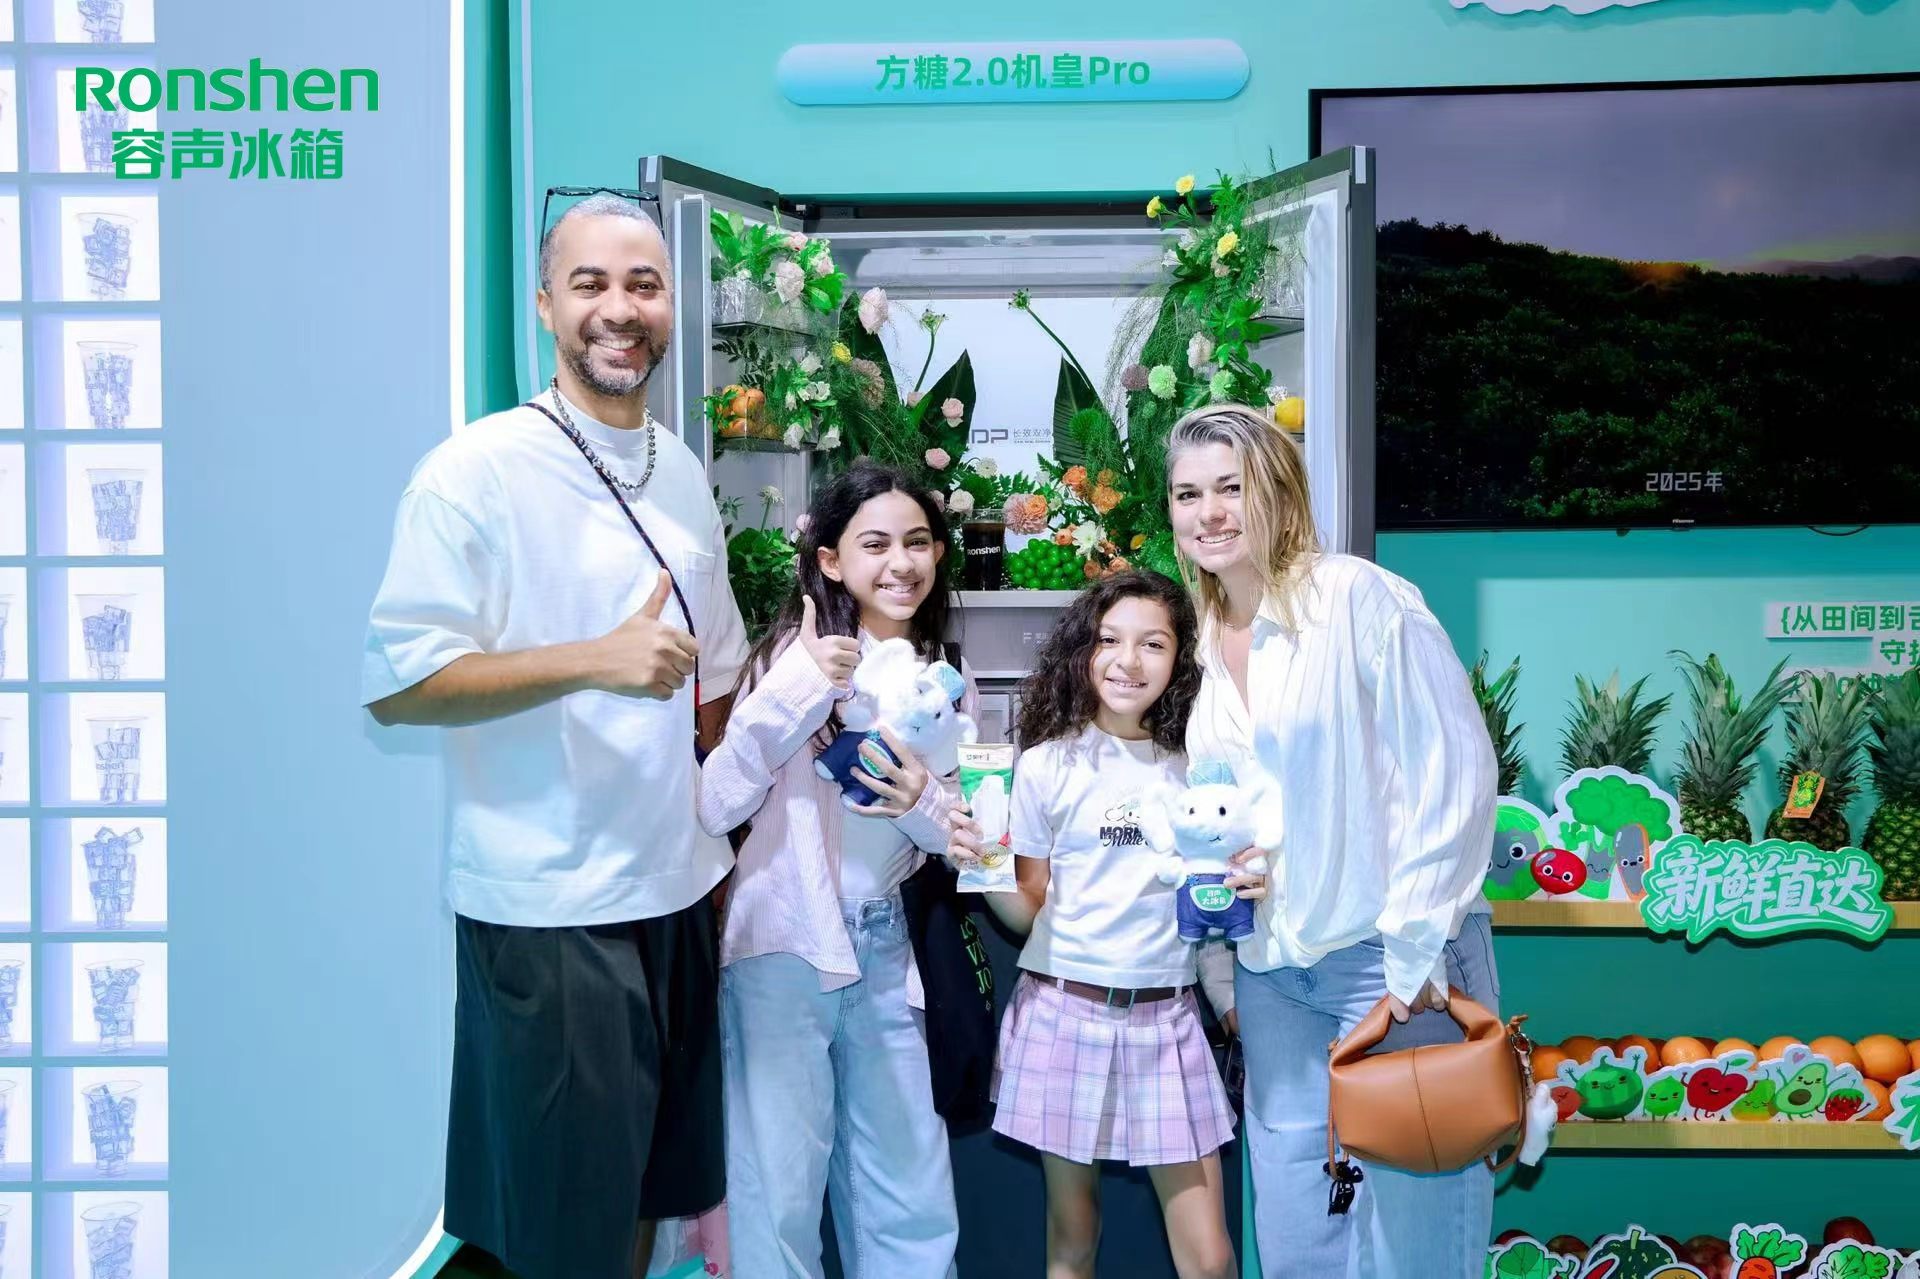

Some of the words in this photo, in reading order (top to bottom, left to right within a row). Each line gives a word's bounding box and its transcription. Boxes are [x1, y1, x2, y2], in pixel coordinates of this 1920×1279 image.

[875, 53, 1151, 91] 方糖2.0机皇Pro
[968, 429, 1009, 444] DP
[1645, 470, 1723, 493] 2025年
[1099, 826, 1144, 840] MORN
[1653, 846, 1880, 930] 新鲜直达
